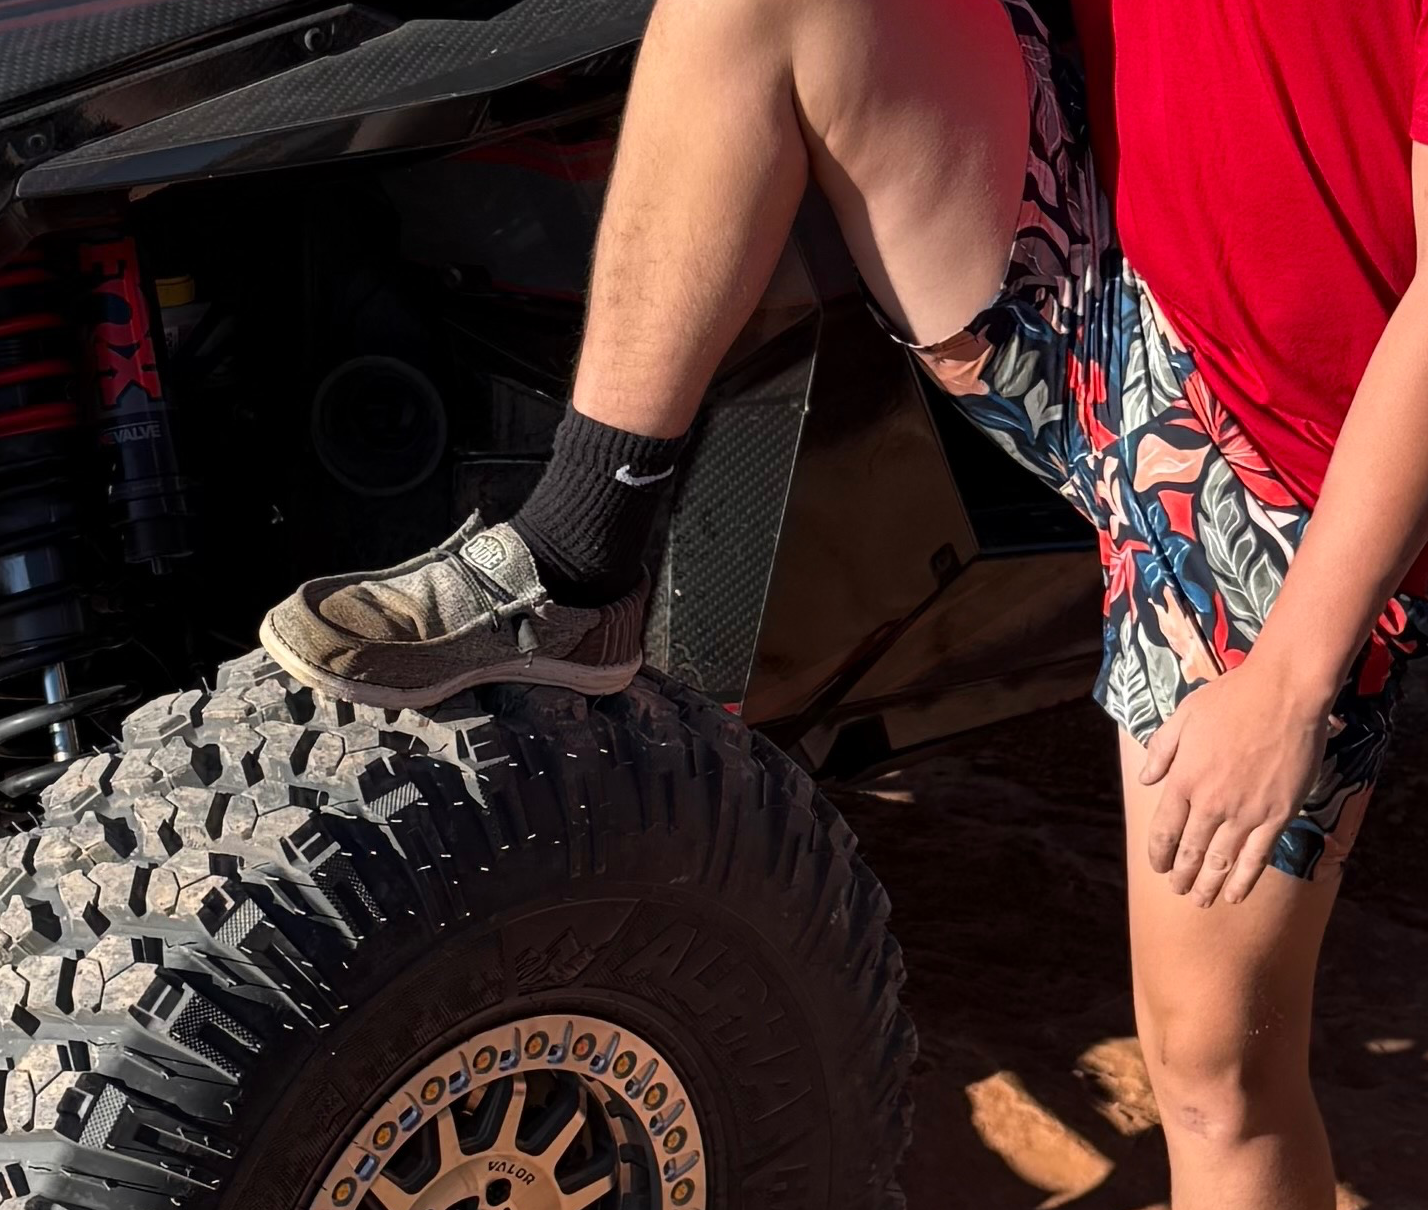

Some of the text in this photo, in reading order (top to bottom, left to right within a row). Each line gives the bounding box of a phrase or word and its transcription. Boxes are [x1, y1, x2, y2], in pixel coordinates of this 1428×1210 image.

[76, 235, 164, 407] FOX
[467, 538, 503, 569] DUDE
[612, 915, 813, 1125] ALPHA
[488, 1160, 537, 1186] VALOR
